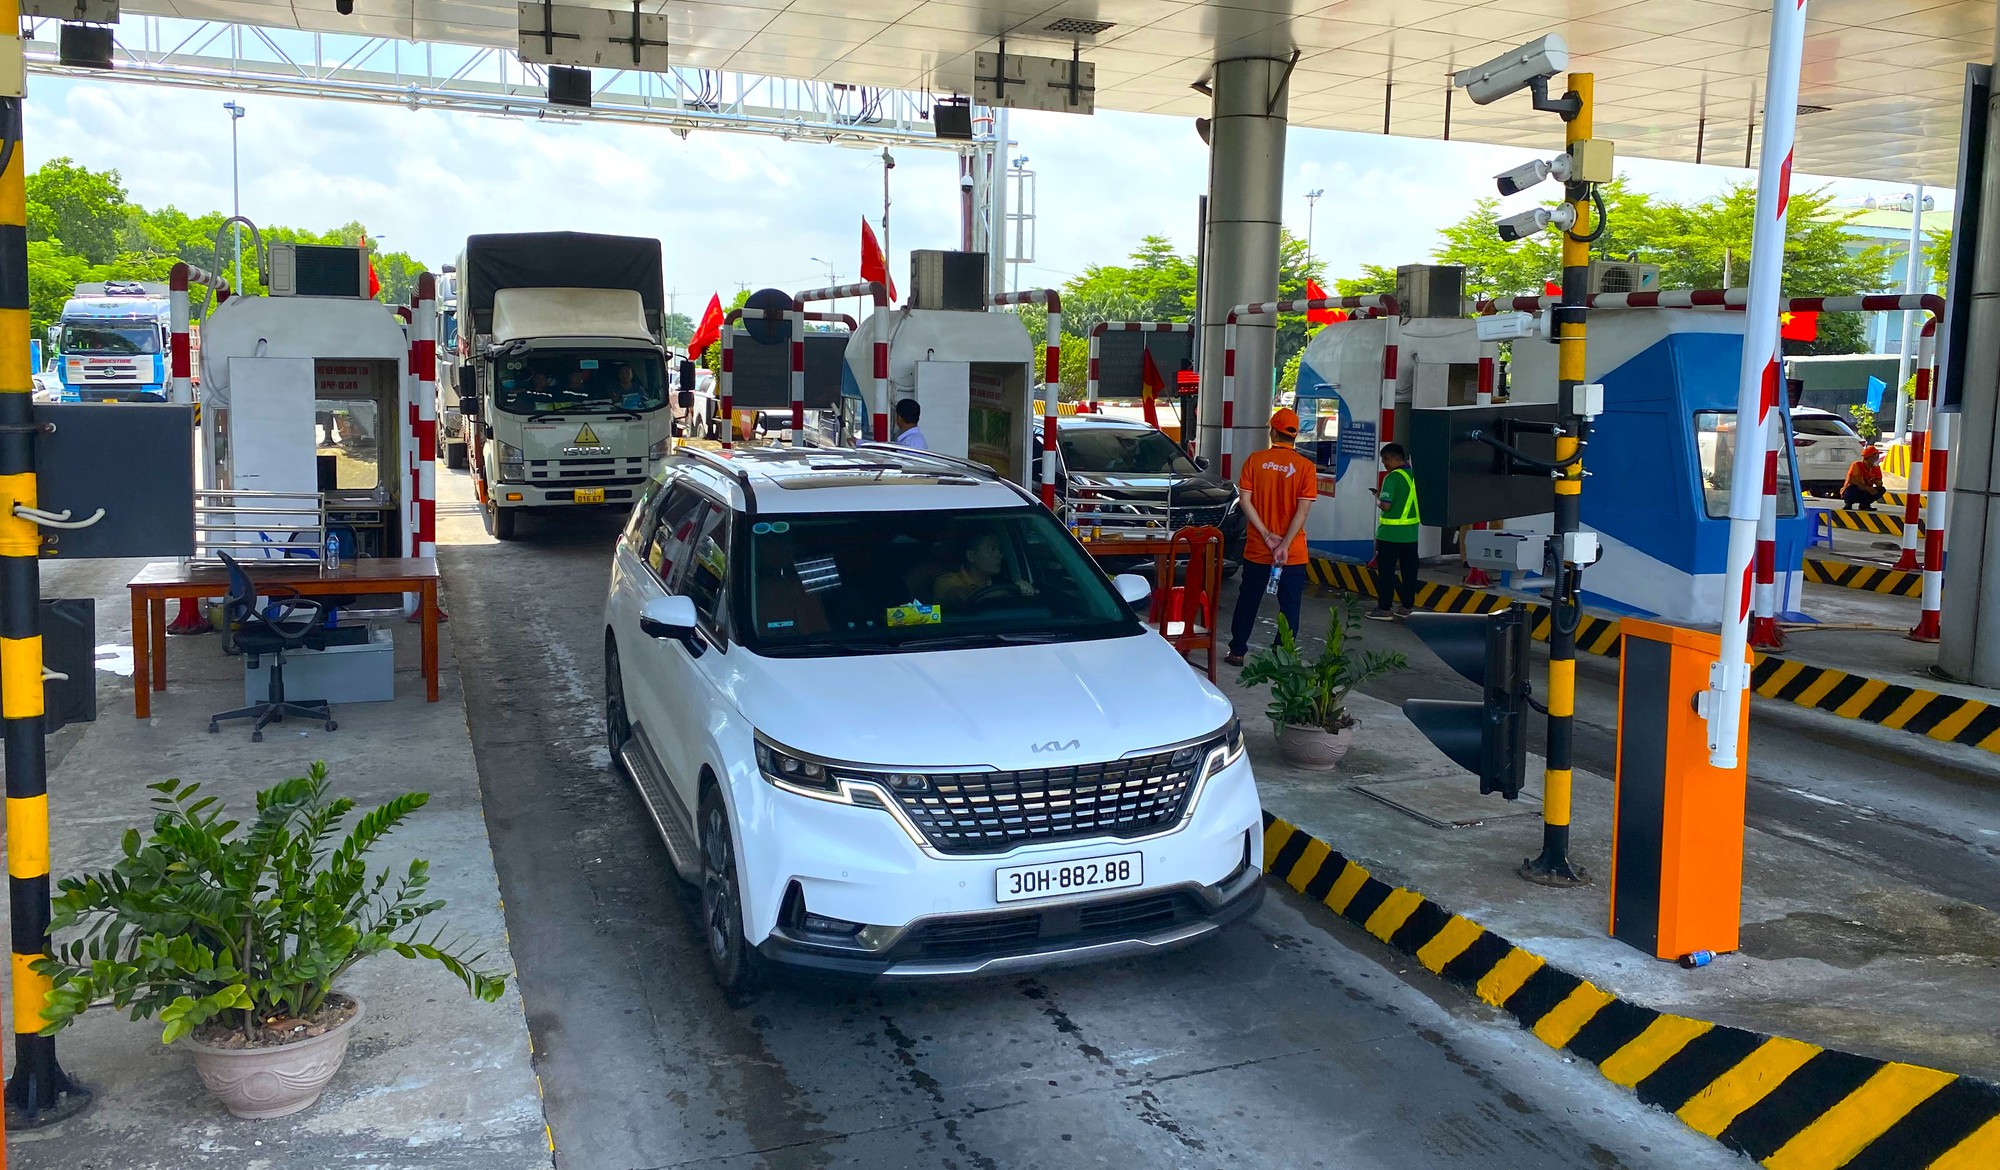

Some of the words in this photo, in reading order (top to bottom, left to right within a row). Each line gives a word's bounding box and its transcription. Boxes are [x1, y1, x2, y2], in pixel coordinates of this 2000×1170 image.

[563, 446, 612, 456] ISUZU
[1262, 461, 1289, 473] ePass
[1009, 860, 1130, 894] 30H-882.88
